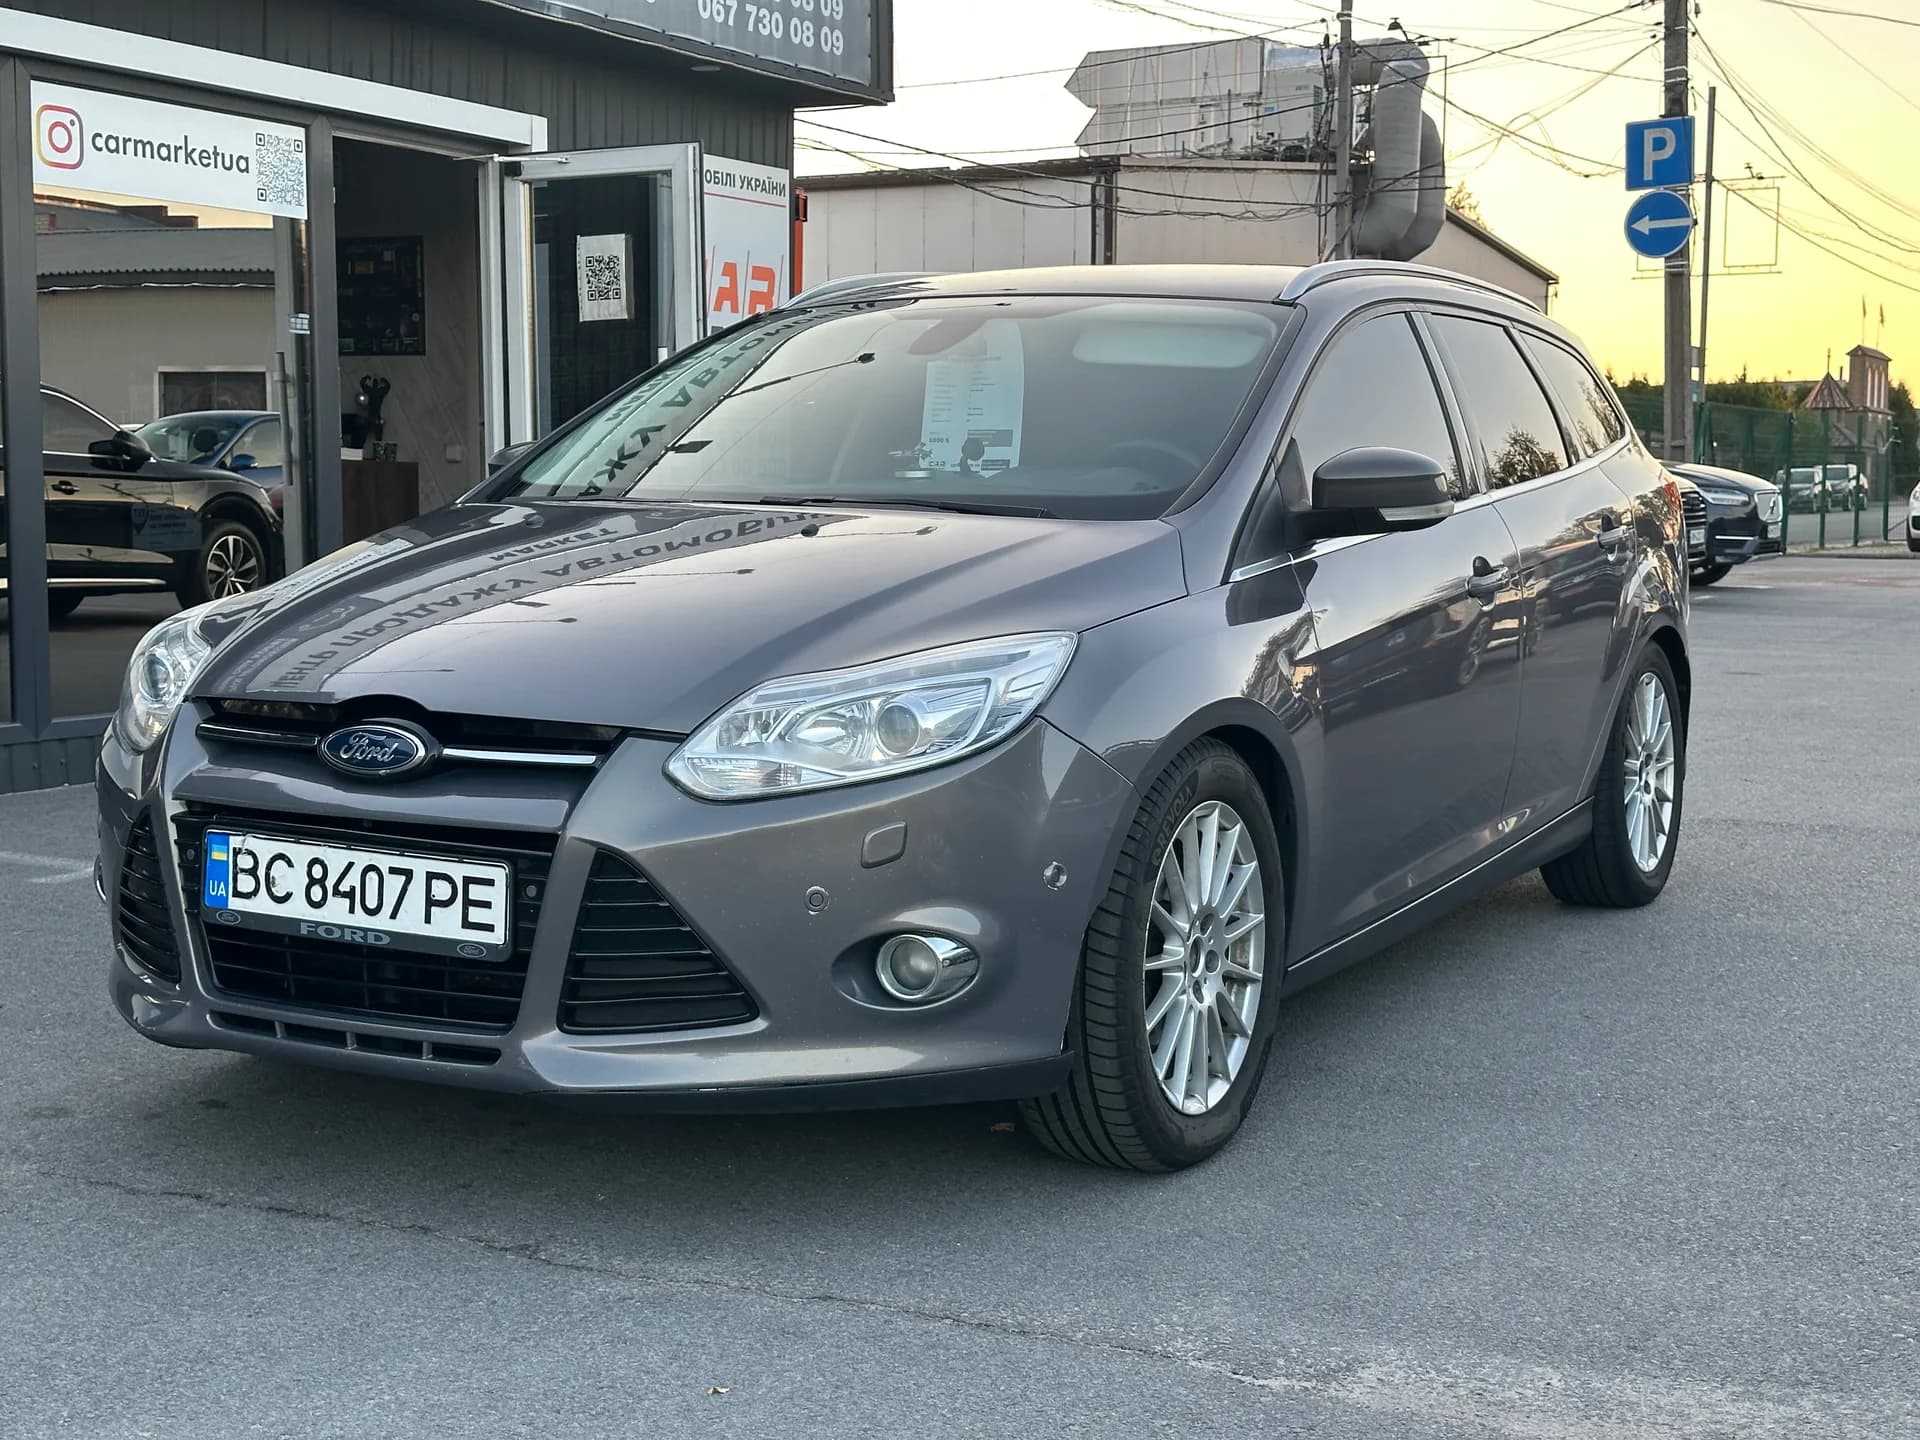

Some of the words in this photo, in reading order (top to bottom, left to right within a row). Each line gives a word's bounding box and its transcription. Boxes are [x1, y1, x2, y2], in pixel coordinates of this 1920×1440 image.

[698, 0, 737, 26] 067
[746, 4, 783, 39] 730
[790, 17, 814, 47] 08
[820, 26, 843, 55] 09
[91, 132, 249, 173] carmarketua
[1644, 127, 1676, 181] P
[739, 176, 786, 197] УКРАЇНИ
[705, 259, 776, 315] AR
[340, 732, 400, 762] Ford
[209, 880, 226, 897] UA
[232, 847, 294, 904] BC
[304, 857, 414, 920] 8407
[424, 871, 496, 933] PE
[299, 922, 391, 945] FORD
